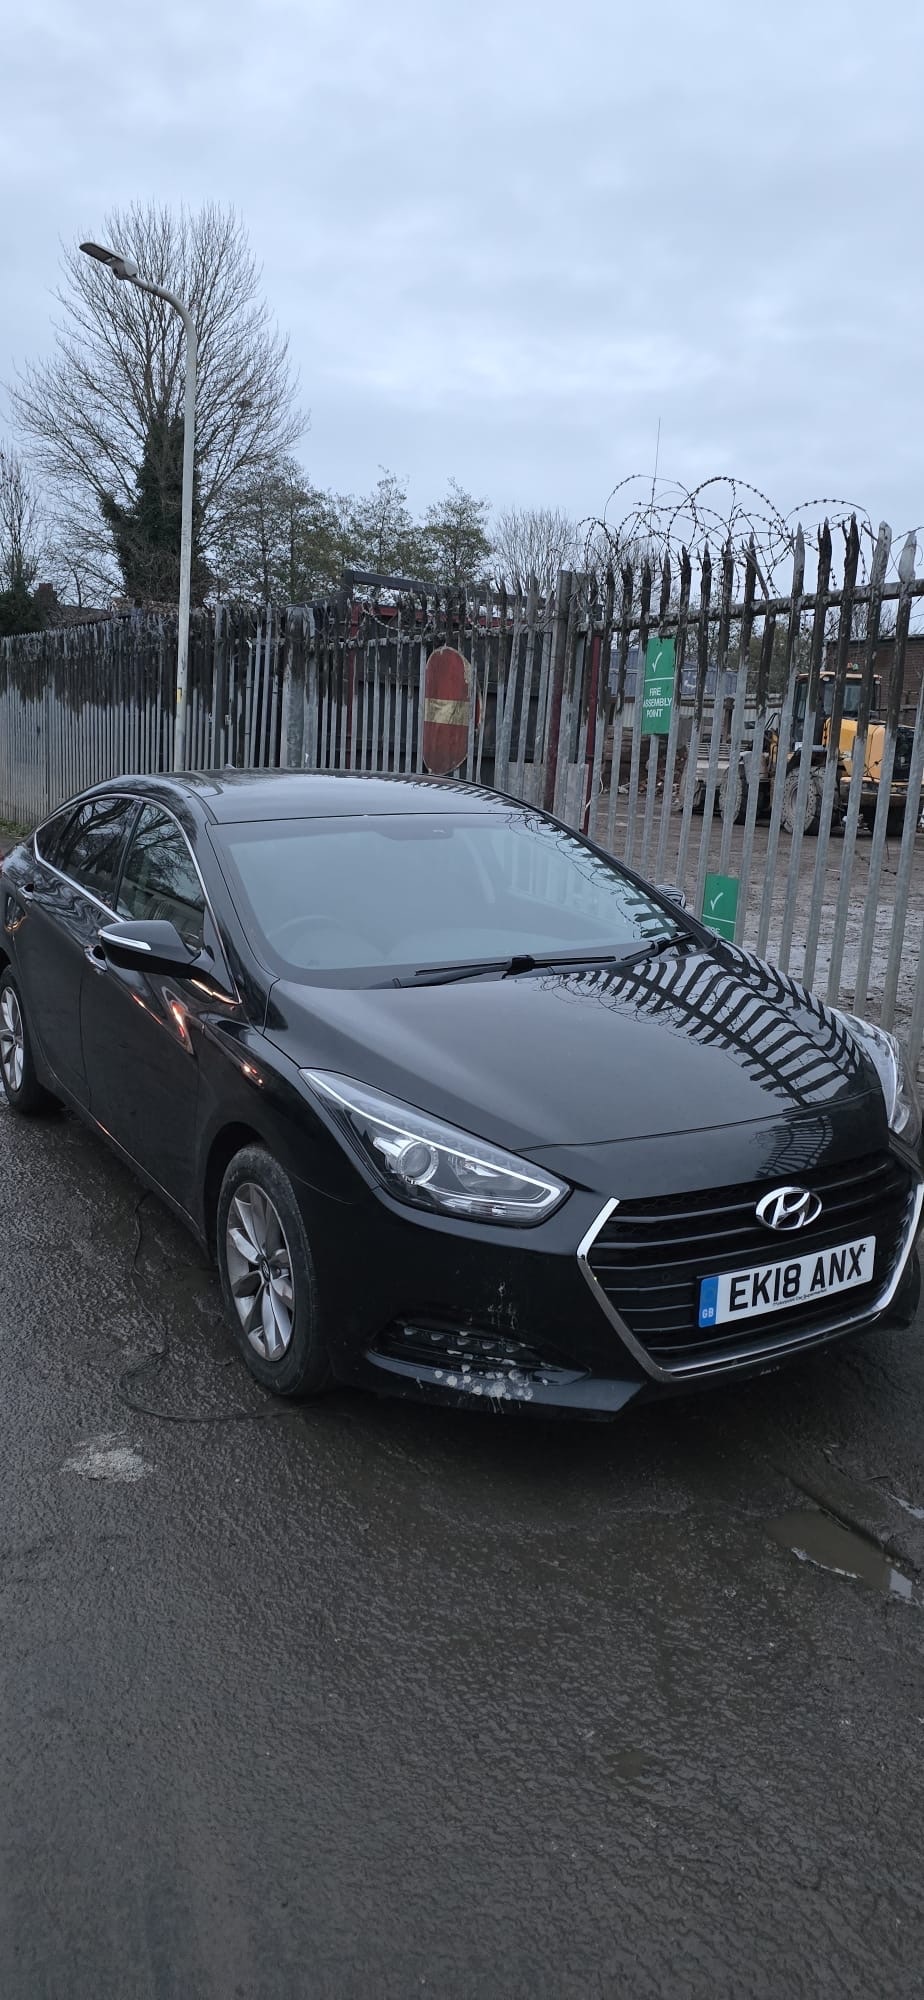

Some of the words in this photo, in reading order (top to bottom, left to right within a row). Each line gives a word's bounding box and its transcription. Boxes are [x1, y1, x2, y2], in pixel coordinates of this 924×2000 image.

[650, 687, 661, 696] FIRE
[646, 708, 663, 718] POINT
[729, 1262, 801, 1312] EK18
[810, 1245, 864, 1292] ANX
[701, 1308, 714, 1319] GB
